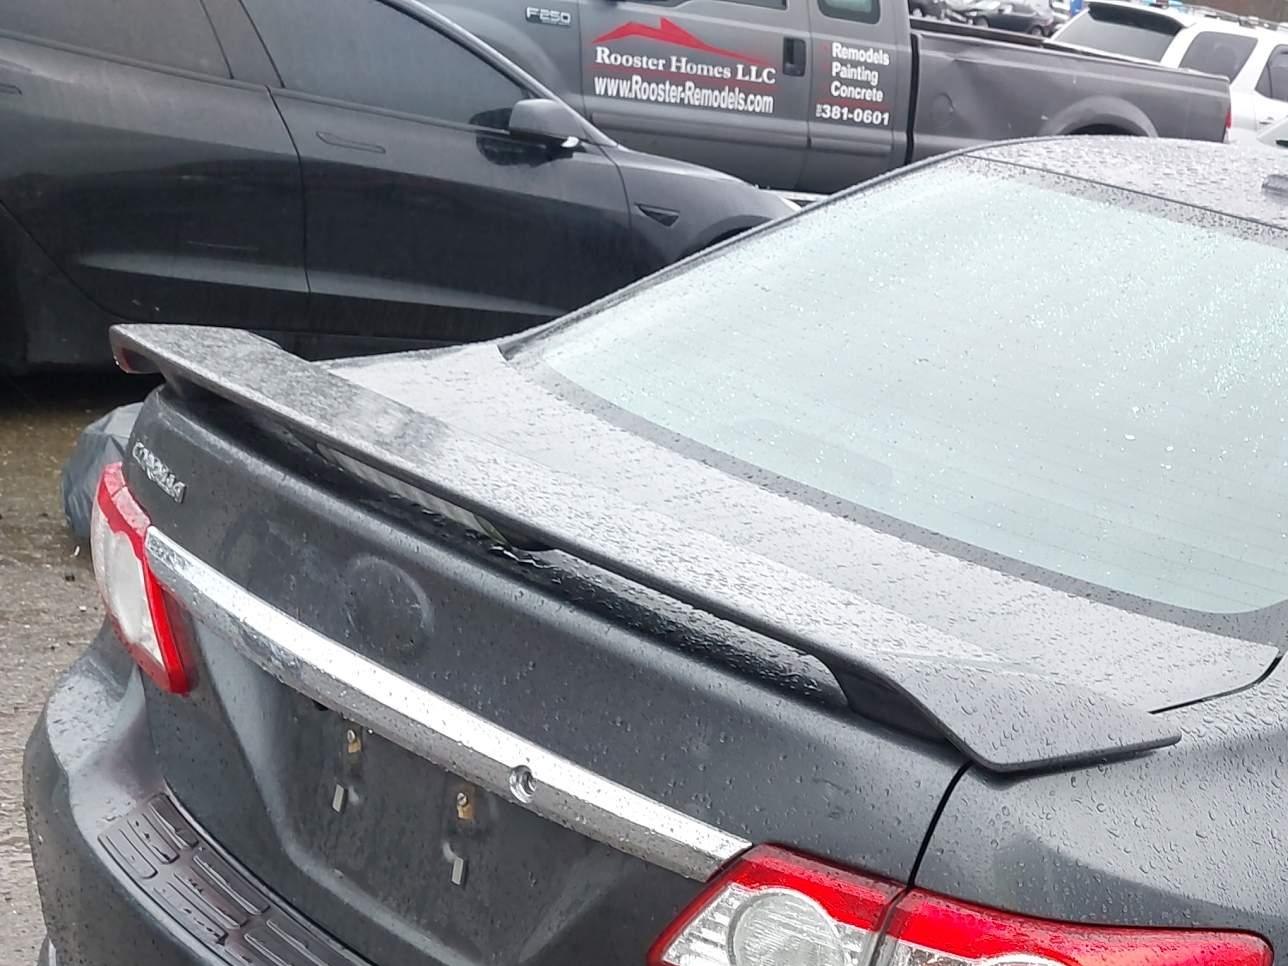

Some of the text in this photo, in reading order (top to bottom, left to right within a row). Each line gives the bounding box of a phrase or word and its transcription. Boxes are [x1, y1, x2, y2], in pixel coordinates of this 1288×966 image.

[595, 46, 777, 85] Rooster Homes LLC
[831, 41, 890, 66] Remodels
[831, 61, 879, 86] Painting
[593, 74, 774, 114] www.Rooster-Remodels.com
[830, 80, 884, 102] Concrete
